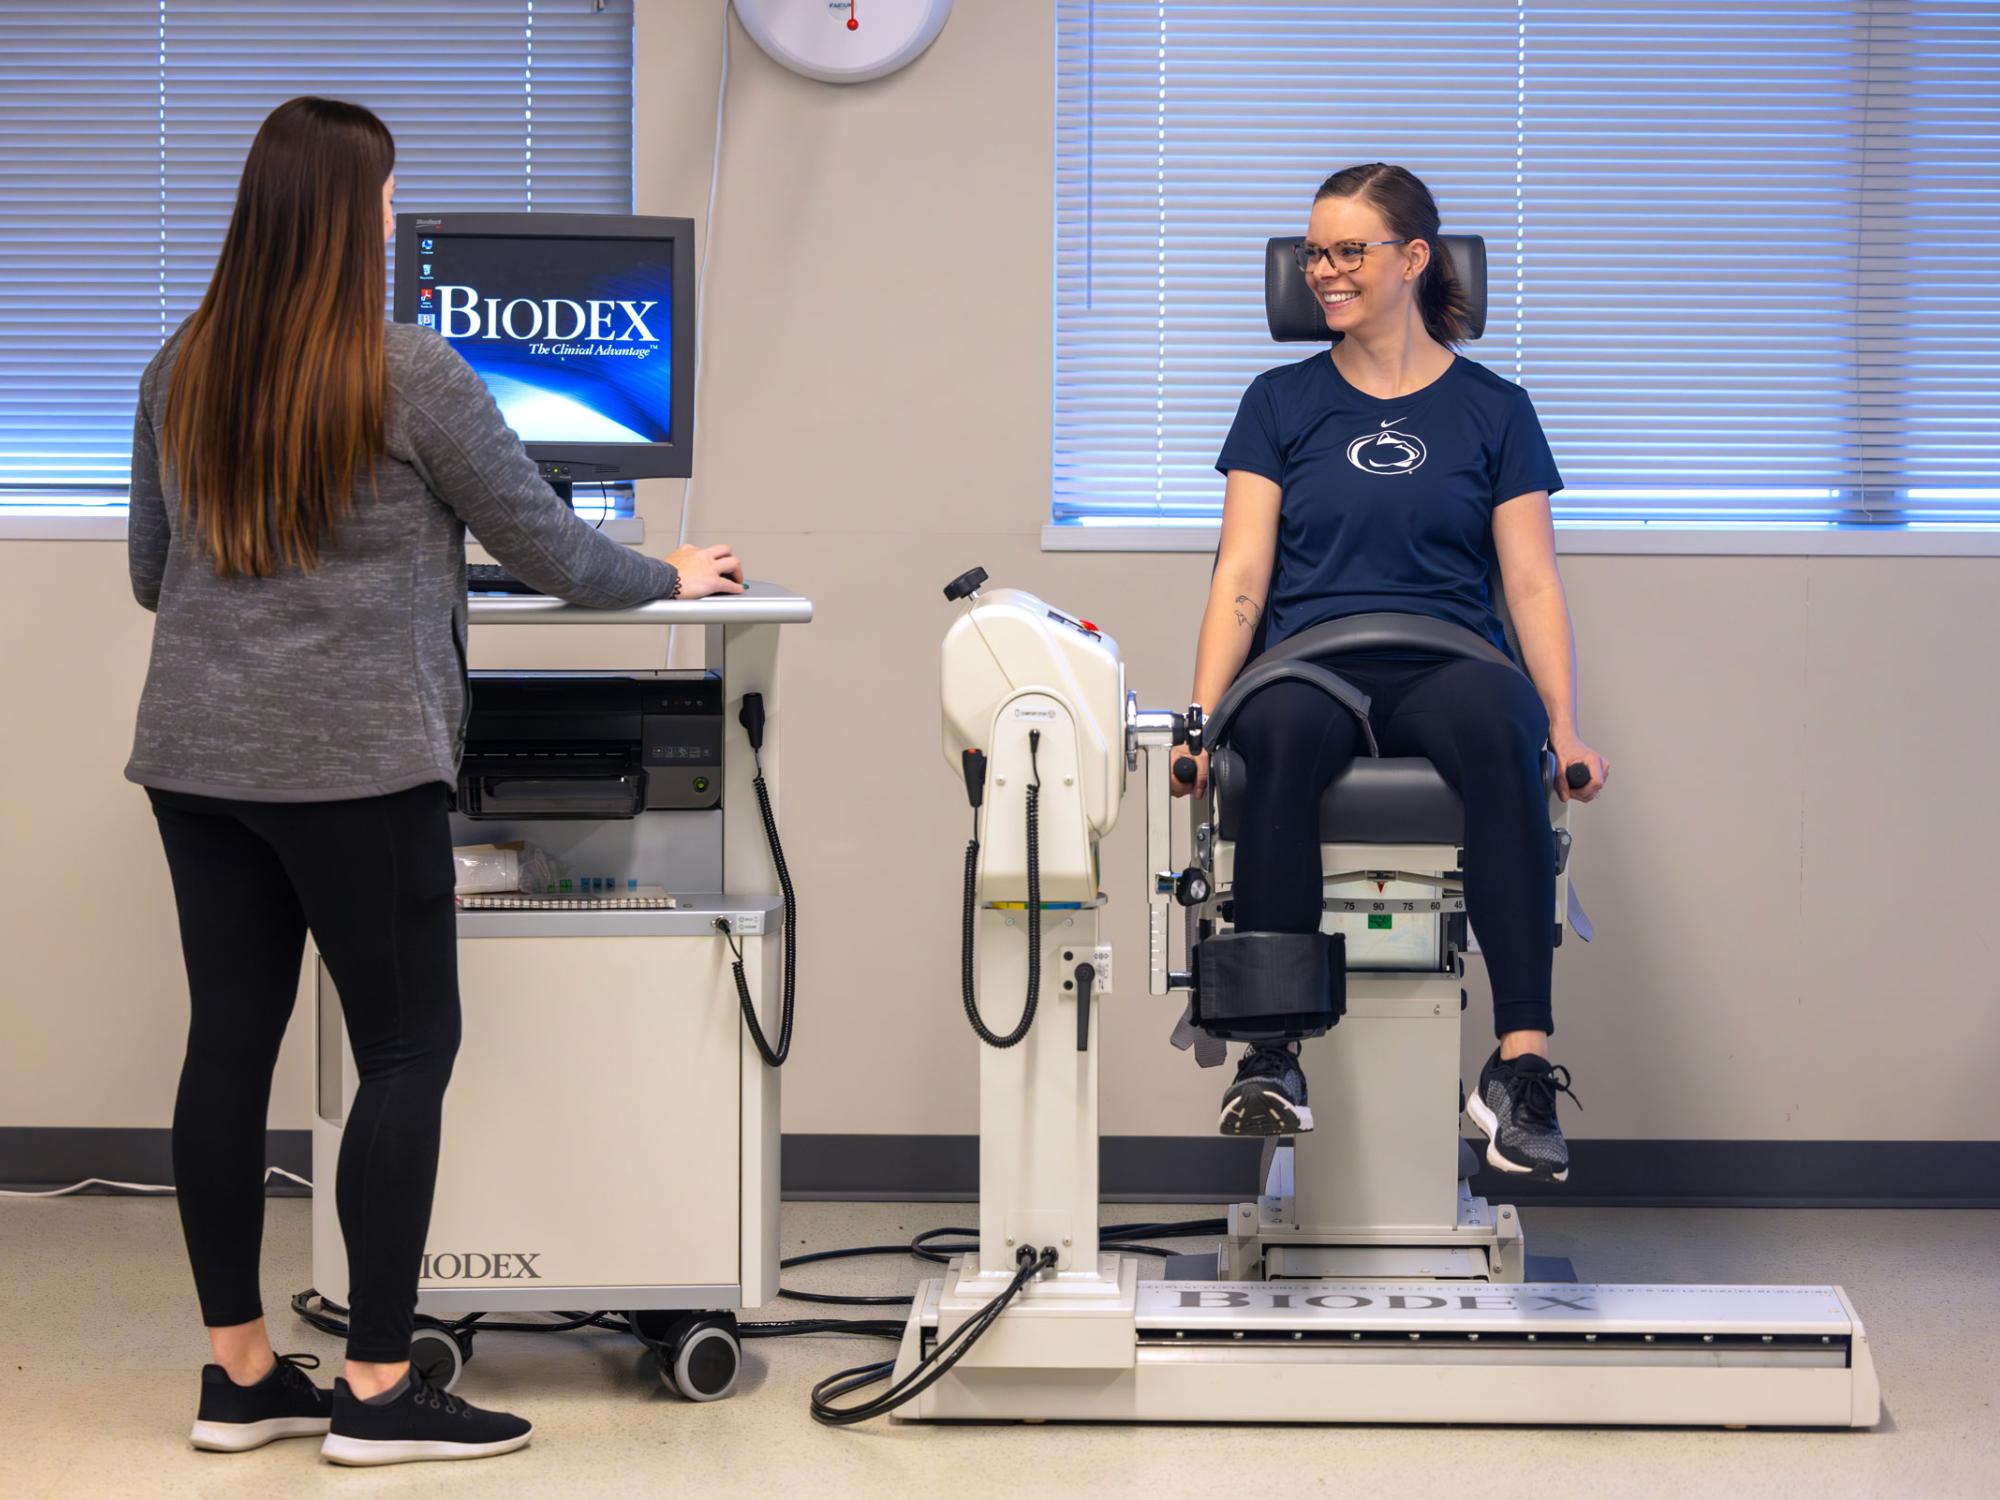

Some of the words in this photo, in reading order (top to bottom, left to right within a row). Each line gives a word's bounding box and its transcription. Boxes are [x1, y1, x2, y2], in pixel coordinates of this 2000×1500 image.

[435, 286, 659, 341] BIODEX
[529, 344, 550, 355] The
[552, 344, 594, 355] Clinical
[1343, 902, 1355, 910] 75
[1373, 902, 1385, 911] 90
[1402, 902, 1414, 911] 75
[1430, 901, 1440, 910] 60
[1454, 900, 1463, 909] 45
[420, 1253, 541, 1279] IODEX
[1171, 1290, 1597, 1311] BIODEX
